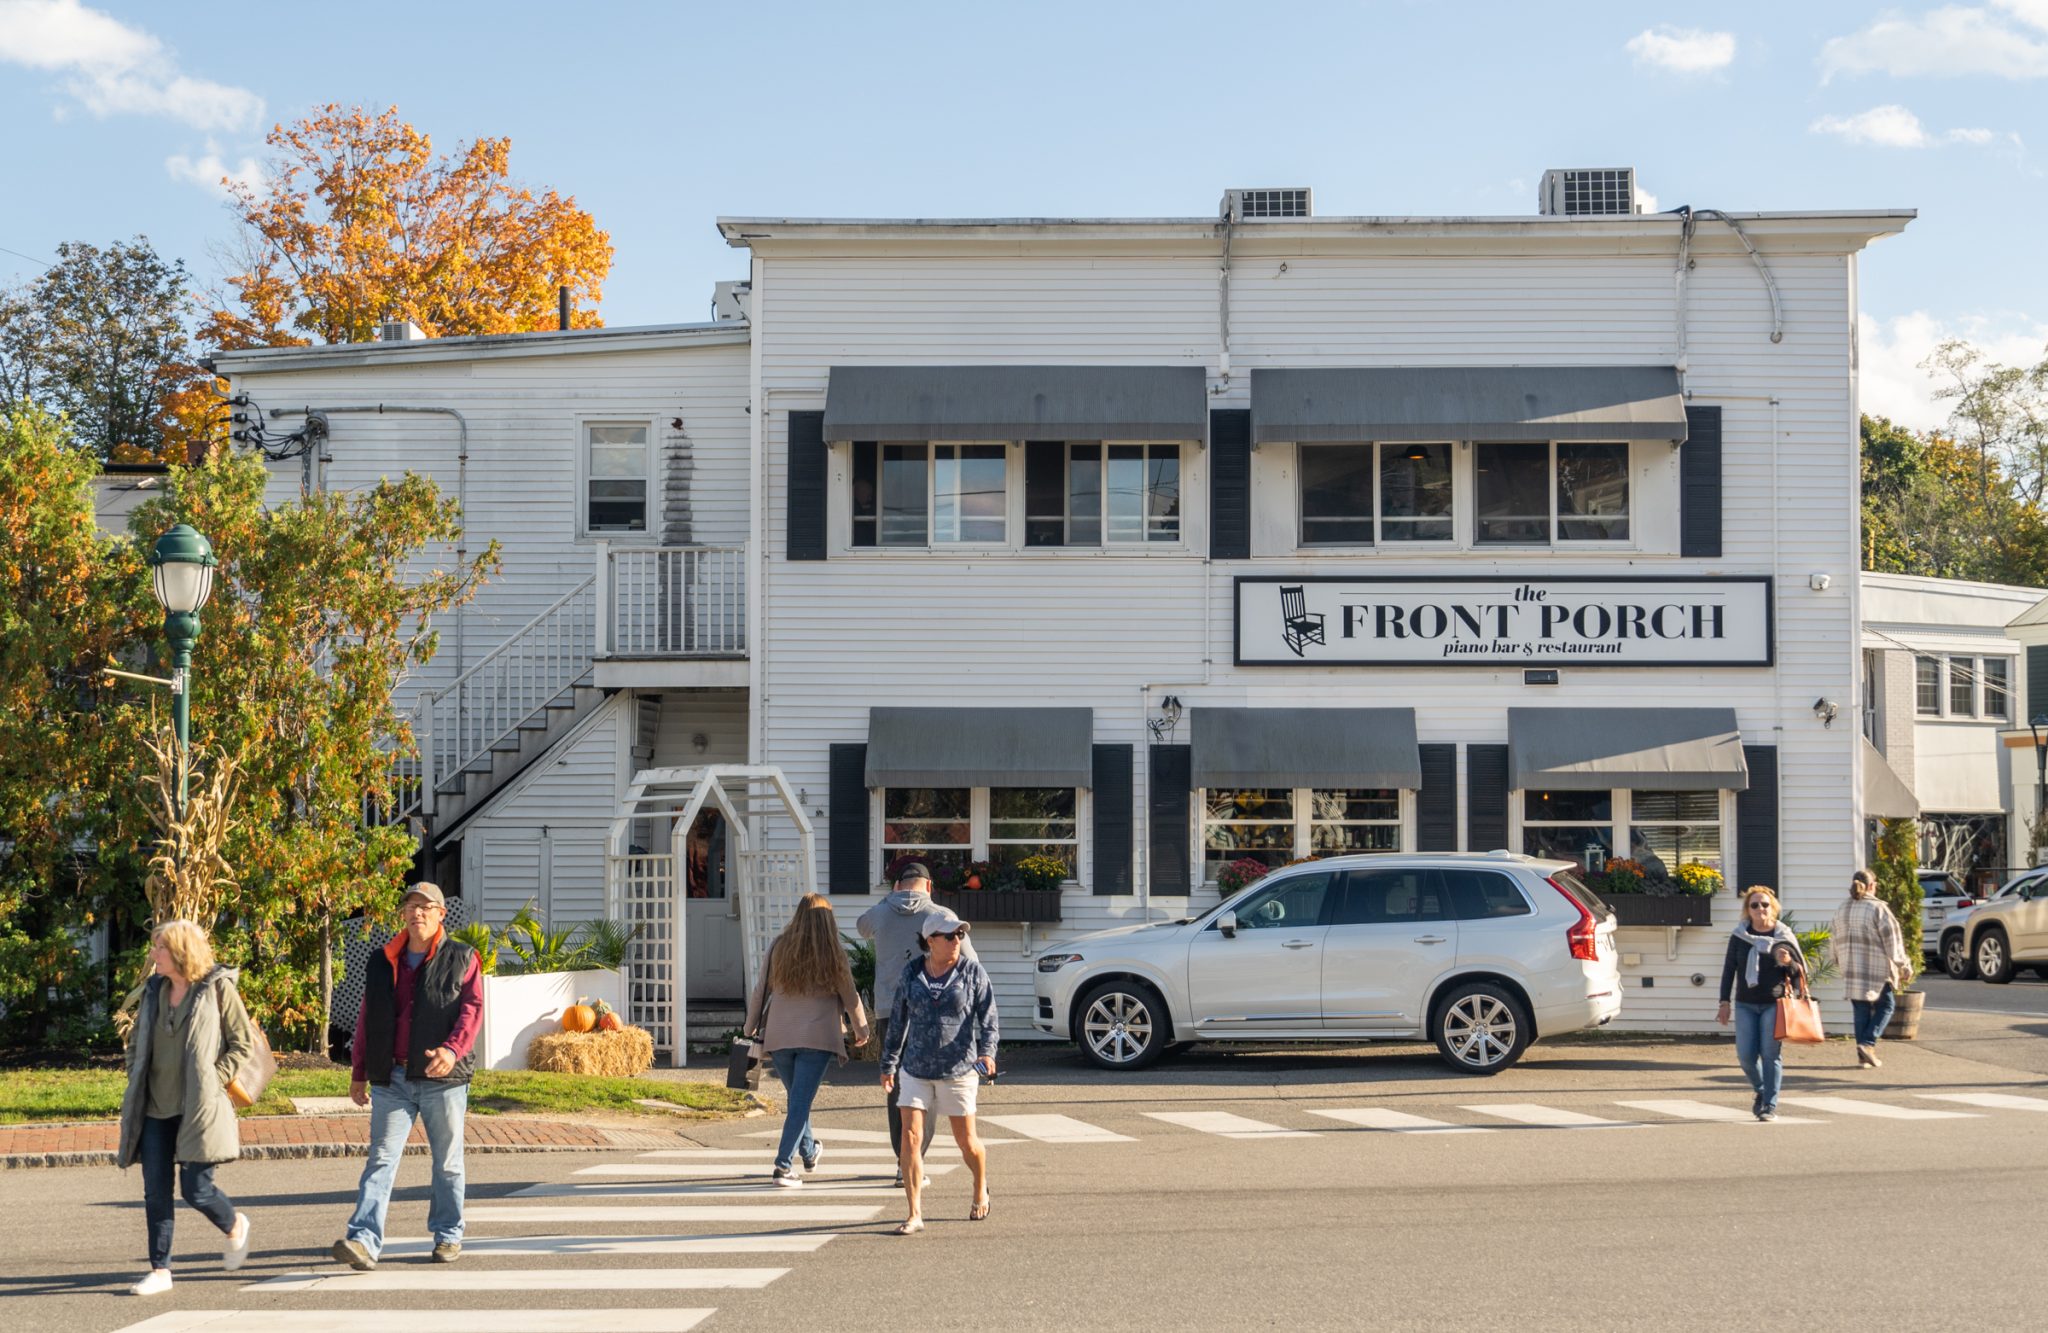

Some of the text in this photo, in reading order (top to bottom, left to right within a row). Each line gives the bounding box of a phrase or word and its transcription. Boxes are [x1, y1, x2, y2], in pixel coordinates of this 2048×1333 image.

[1514, 584, 1547, 602] the
[1340, 604, 1728, 640] FRONT PORCH
[1442, 639, 1623, 657] piano bar & restaurant
